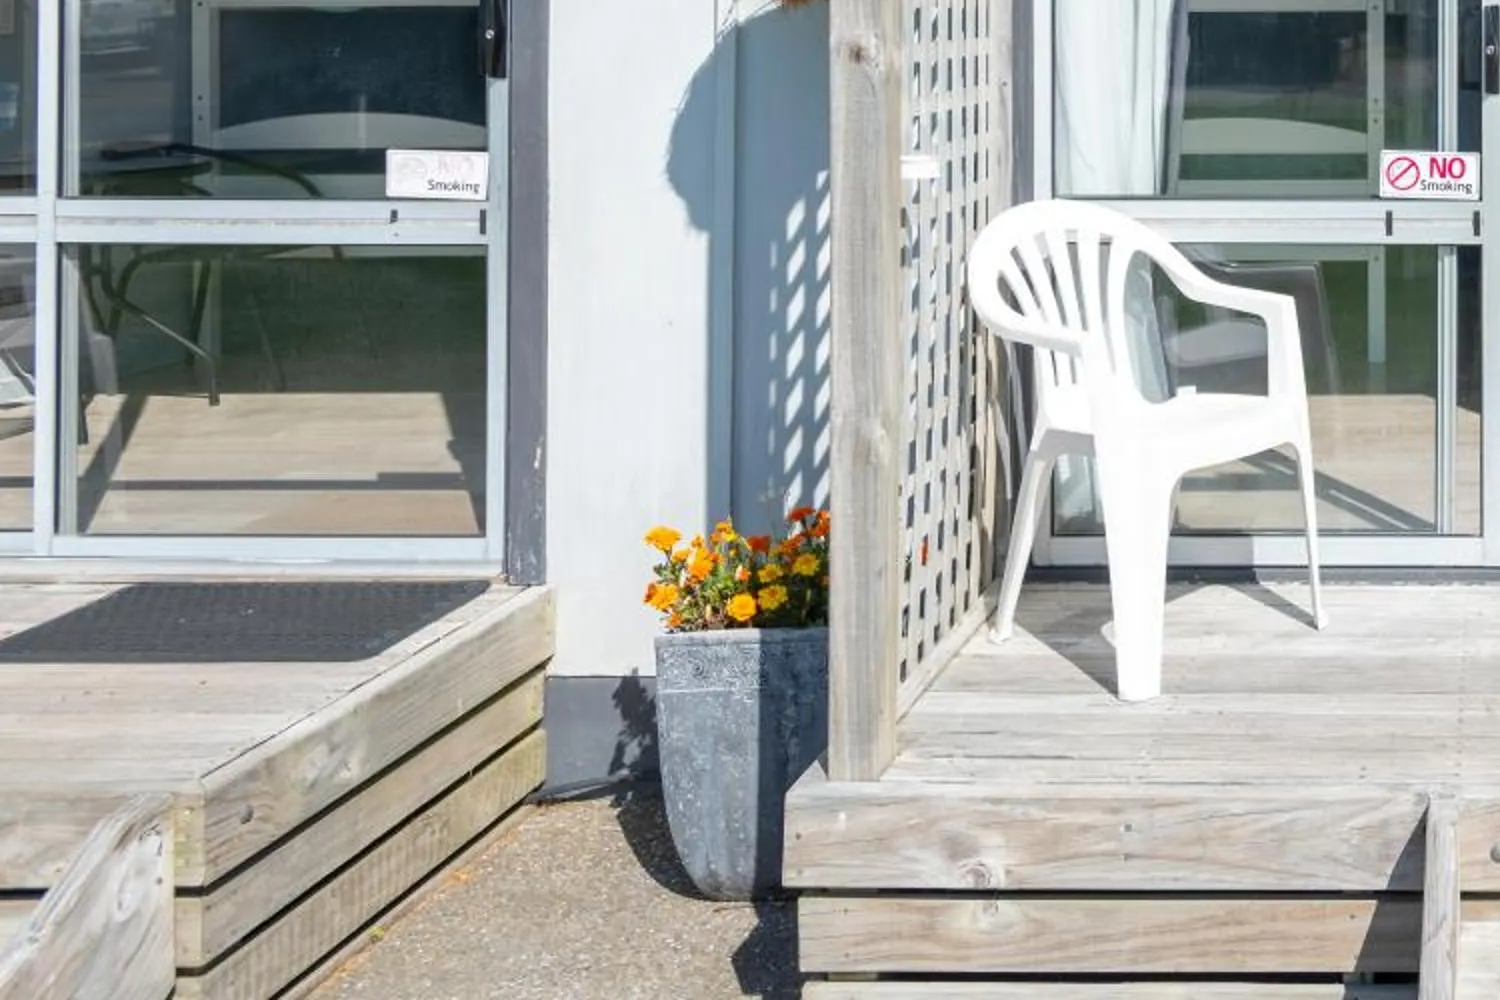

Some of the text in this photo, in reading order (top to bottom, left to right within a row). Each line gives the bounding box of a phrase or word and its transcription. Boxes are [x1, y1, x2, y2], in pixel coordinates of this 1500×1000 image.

[1429, 156, 1466, 179] NO
[427, 178, 481, 194] Smoking
[1420, 179, 1473, 195] Smoking
